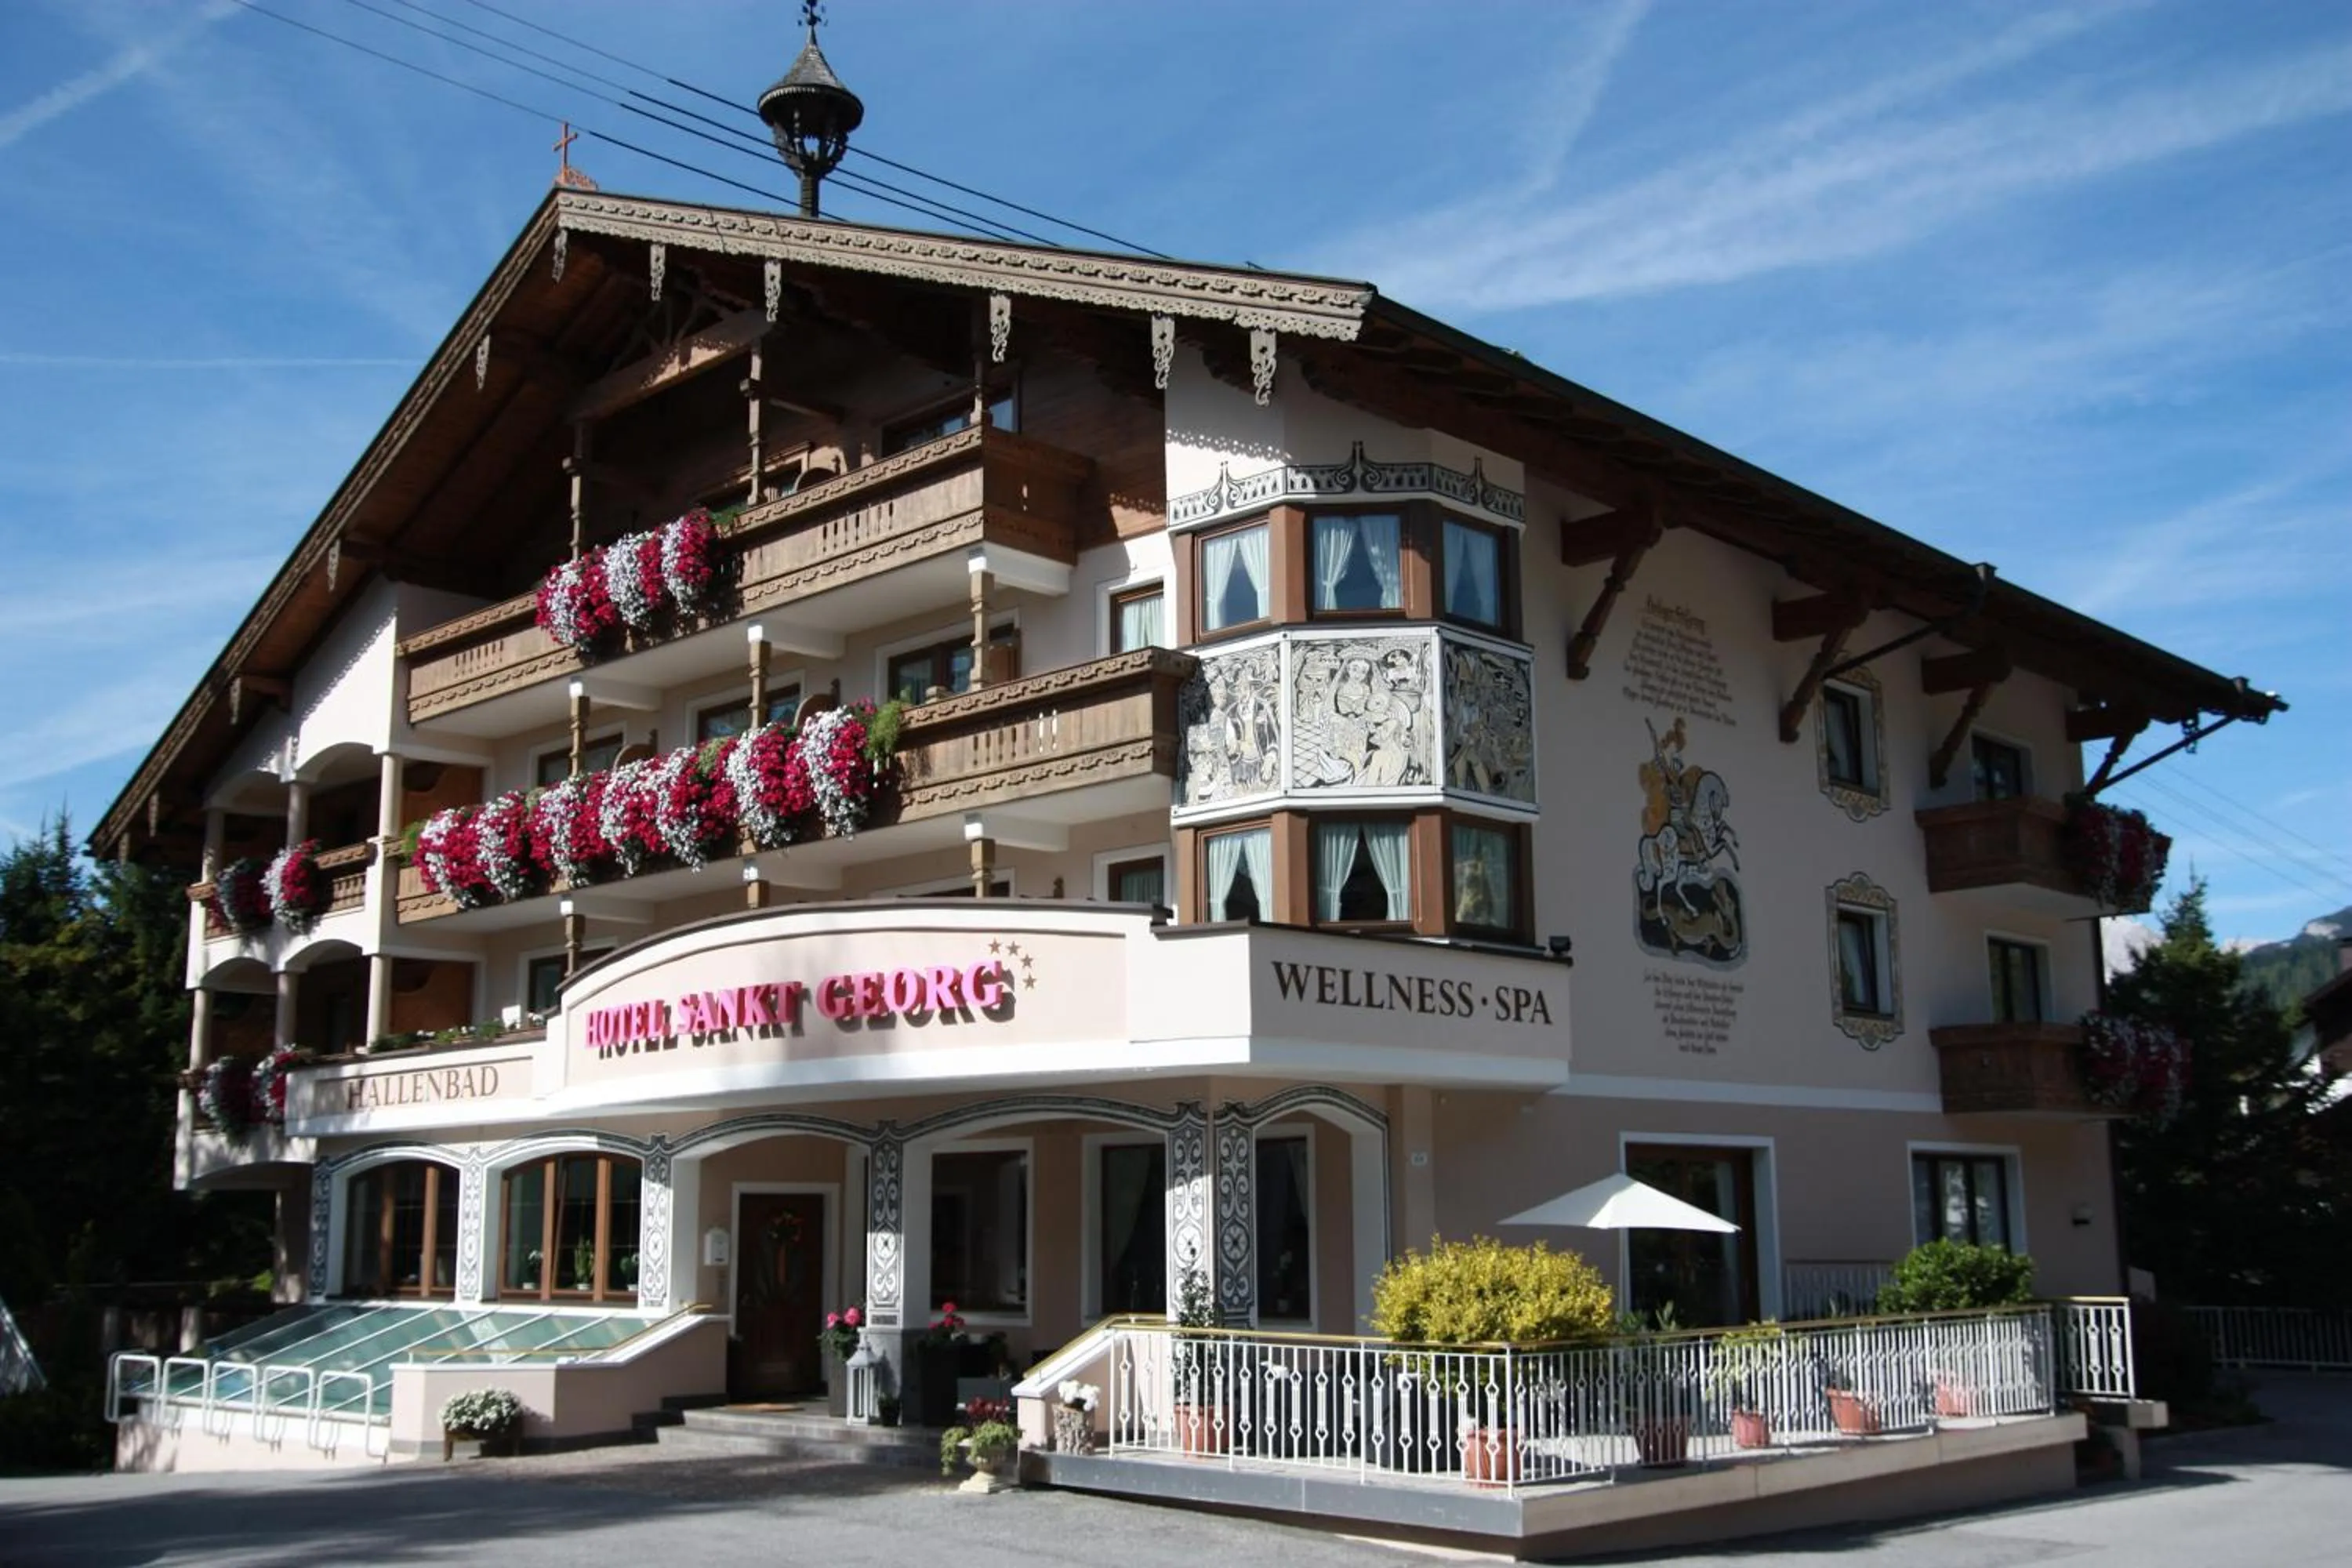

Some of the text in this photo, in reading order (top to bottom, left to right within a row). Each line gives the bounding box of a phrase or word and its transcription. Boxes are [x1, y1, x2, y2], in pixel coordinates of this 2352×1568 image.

[586, 960, 1004, 1047] HOTEL SANKT GEORG
[1271, 960, 1554, 1025] WELLNESS SPA
[347, 1065, 499, 1110] HALLENBAD
